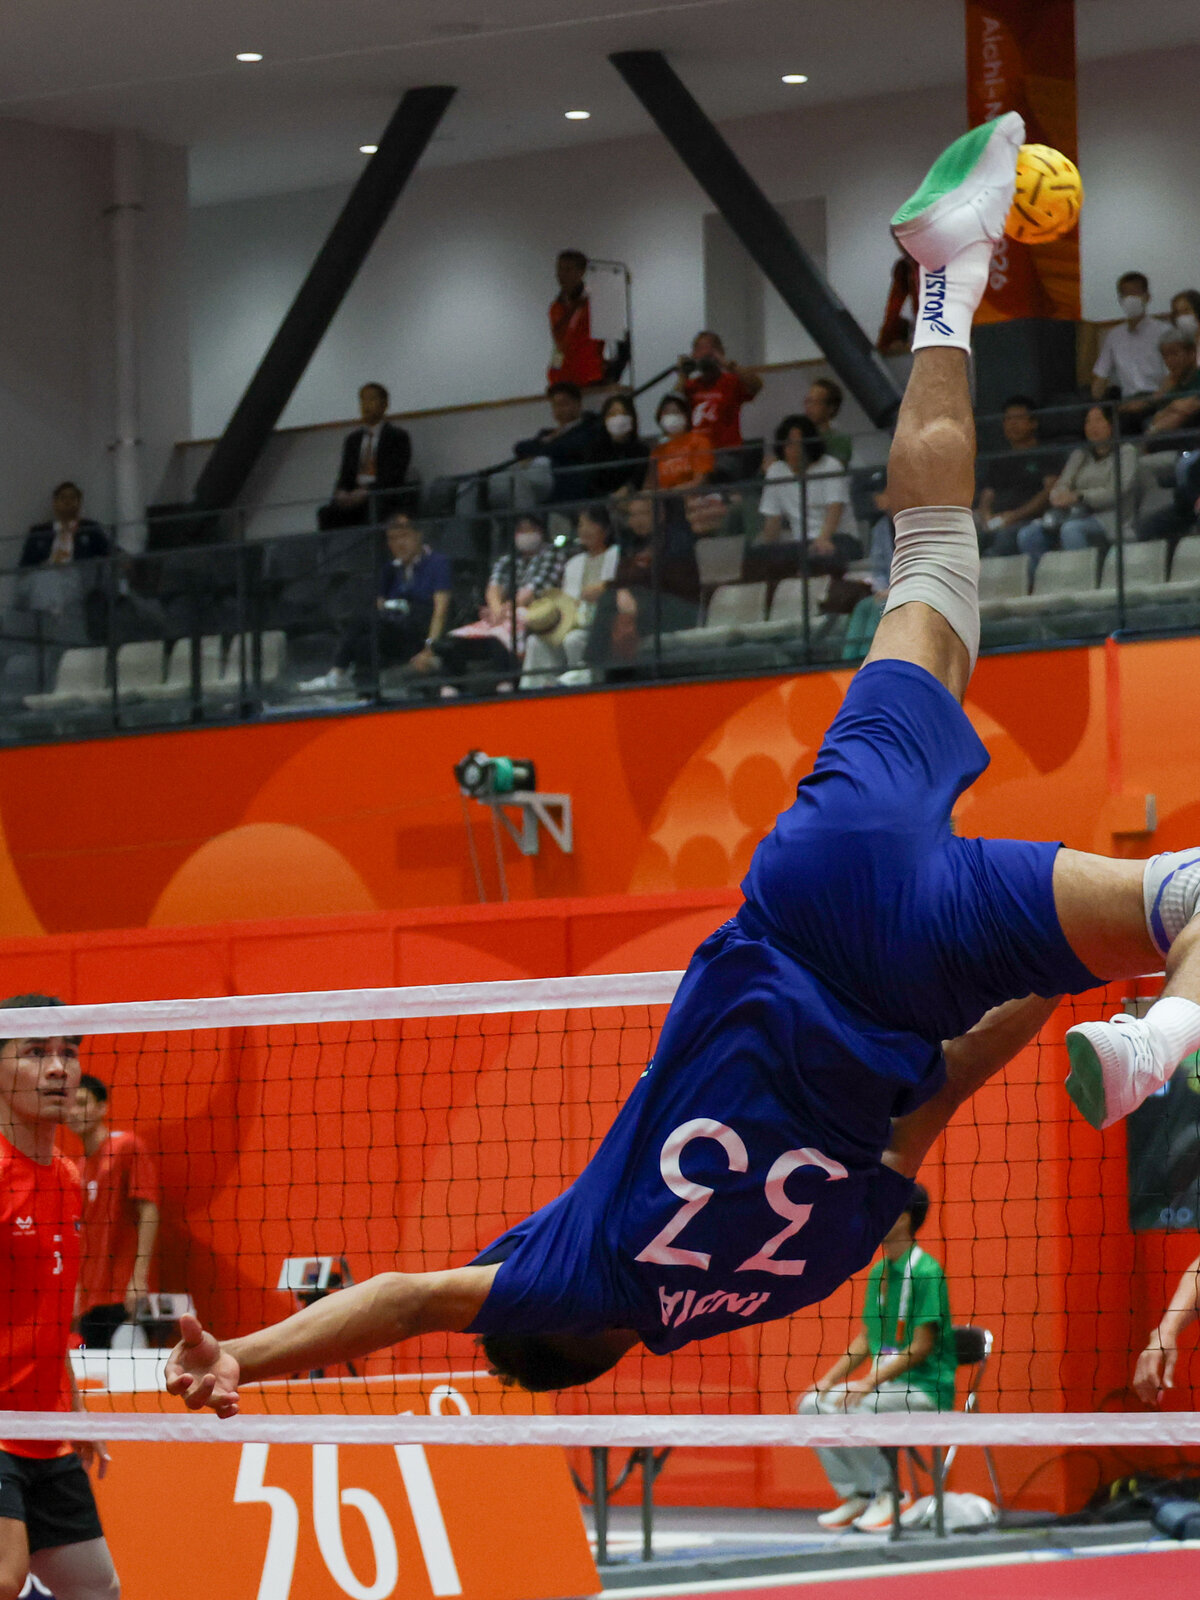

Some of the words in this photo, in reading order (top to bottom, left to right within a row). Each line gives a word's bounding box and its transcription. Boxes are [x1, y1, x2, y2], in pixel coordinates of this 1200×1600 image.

[982, 16, 1004, 122] Aichi-N
[989, 238, 1008, 290] 026
[634, 1117, 849, 1277] 33
[658, 1285, 771, 1329] INDIA
